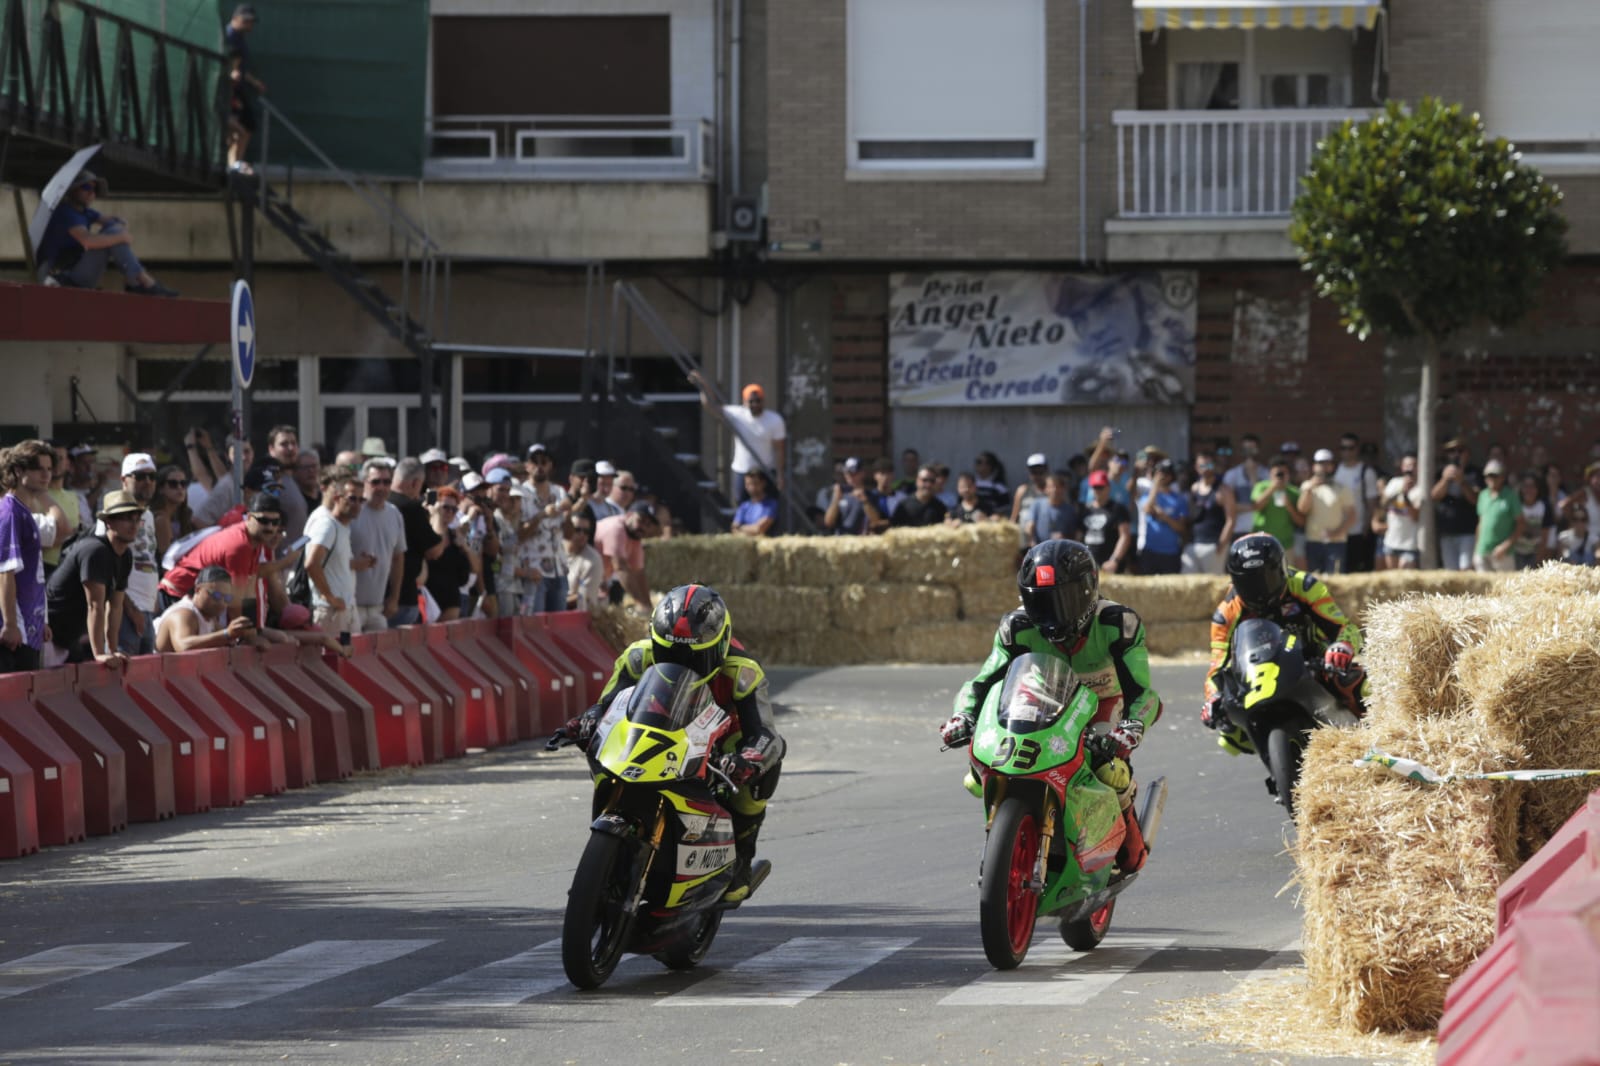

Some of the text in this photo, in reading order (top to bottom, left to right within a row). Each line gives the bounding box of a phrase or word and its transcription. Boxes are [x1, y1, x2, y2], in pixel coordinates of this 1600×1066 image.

[895, 294, 998, 329] Angel
[969, 317, 1065, 349] Nieto
[1244, 661, 1281, 710] 3
[618, 727, 678, 765] 17
[990, 736, 1042, 770] 93
